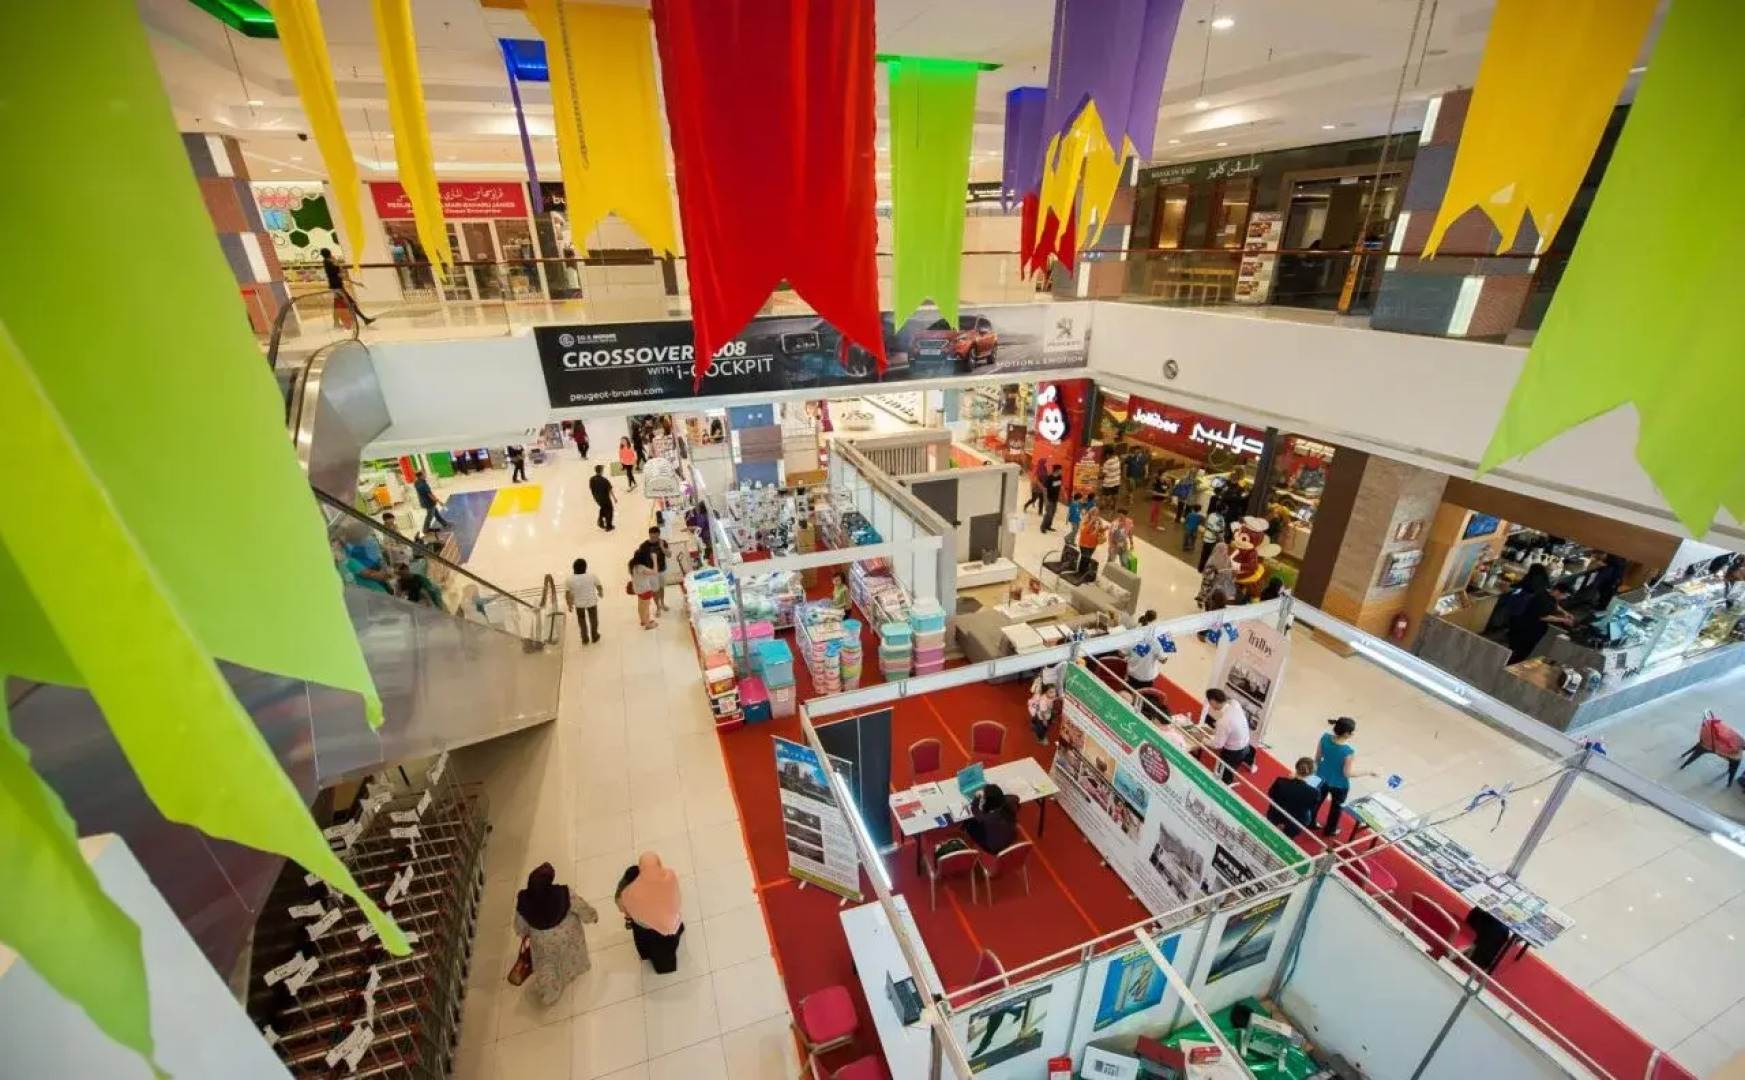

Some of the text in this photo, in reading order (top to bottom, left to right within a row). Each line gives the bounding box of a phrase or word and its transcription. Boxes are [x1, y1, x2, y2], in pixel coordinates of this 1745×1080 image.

[562, 345, 694, 368] CROSSOVER
[997, 359, 1034, 367] MOTION
[1043, 355, 1084, 365] EMOTION
[647, 366, 674, 376] WITH
[570, 387, 664, 402] peugeot-brunei.com
